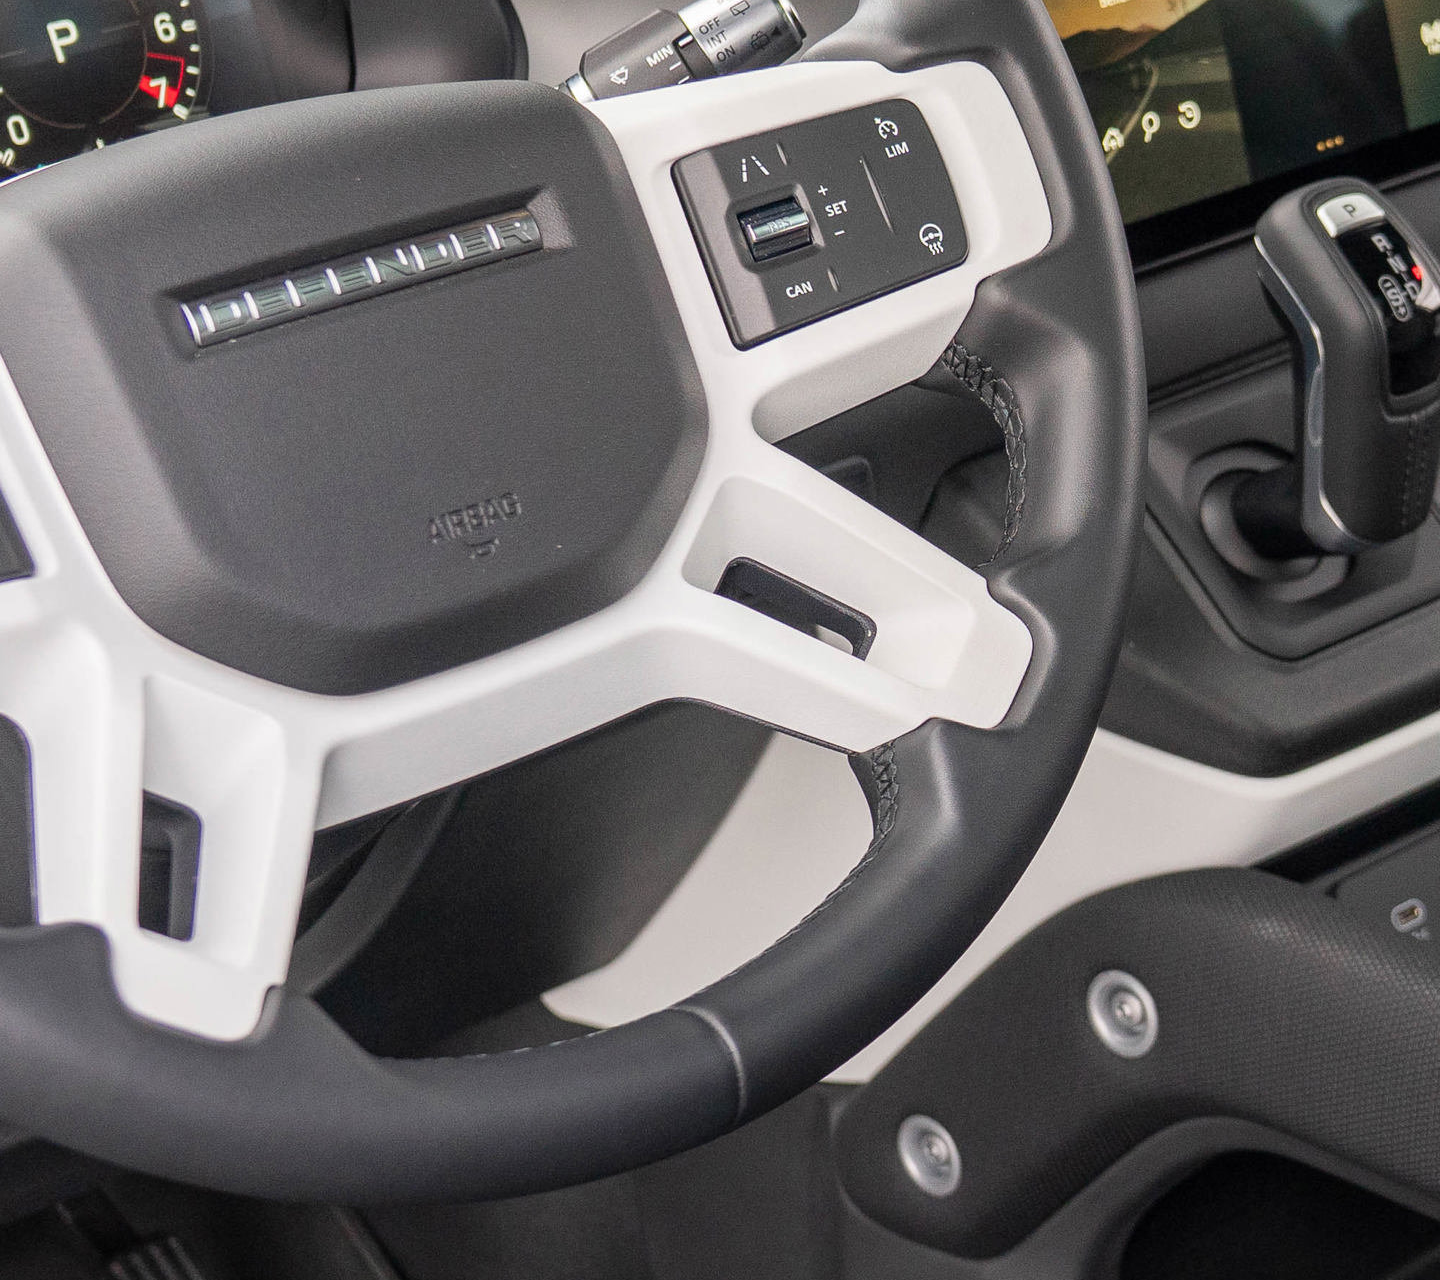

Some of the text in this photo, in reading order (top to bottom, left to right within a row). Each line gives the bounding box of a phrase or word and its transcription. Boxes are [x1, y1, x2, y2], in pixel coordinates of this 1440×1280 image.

[153, 12, 177, 44] 6
[699, 16, 720, 35] OFF
[46, 19, 79, 64] P
[706, 30, 727, 49] INT
[644, 44, 674, 68] MIN
[716, 45, 736, 62] ON
[149, 76, 169, 109] 7
[6, 114, 31, 146] 0
[884, 141, 909, 159] LIM
[824, 200, 848, 217] SET
[1342, 204, 1356, 218] P
[199, 221, 534, 334] DEFENDER
[785, 281, 814, 299] CAN
[429, 492, 522, 543] AIRBAG
